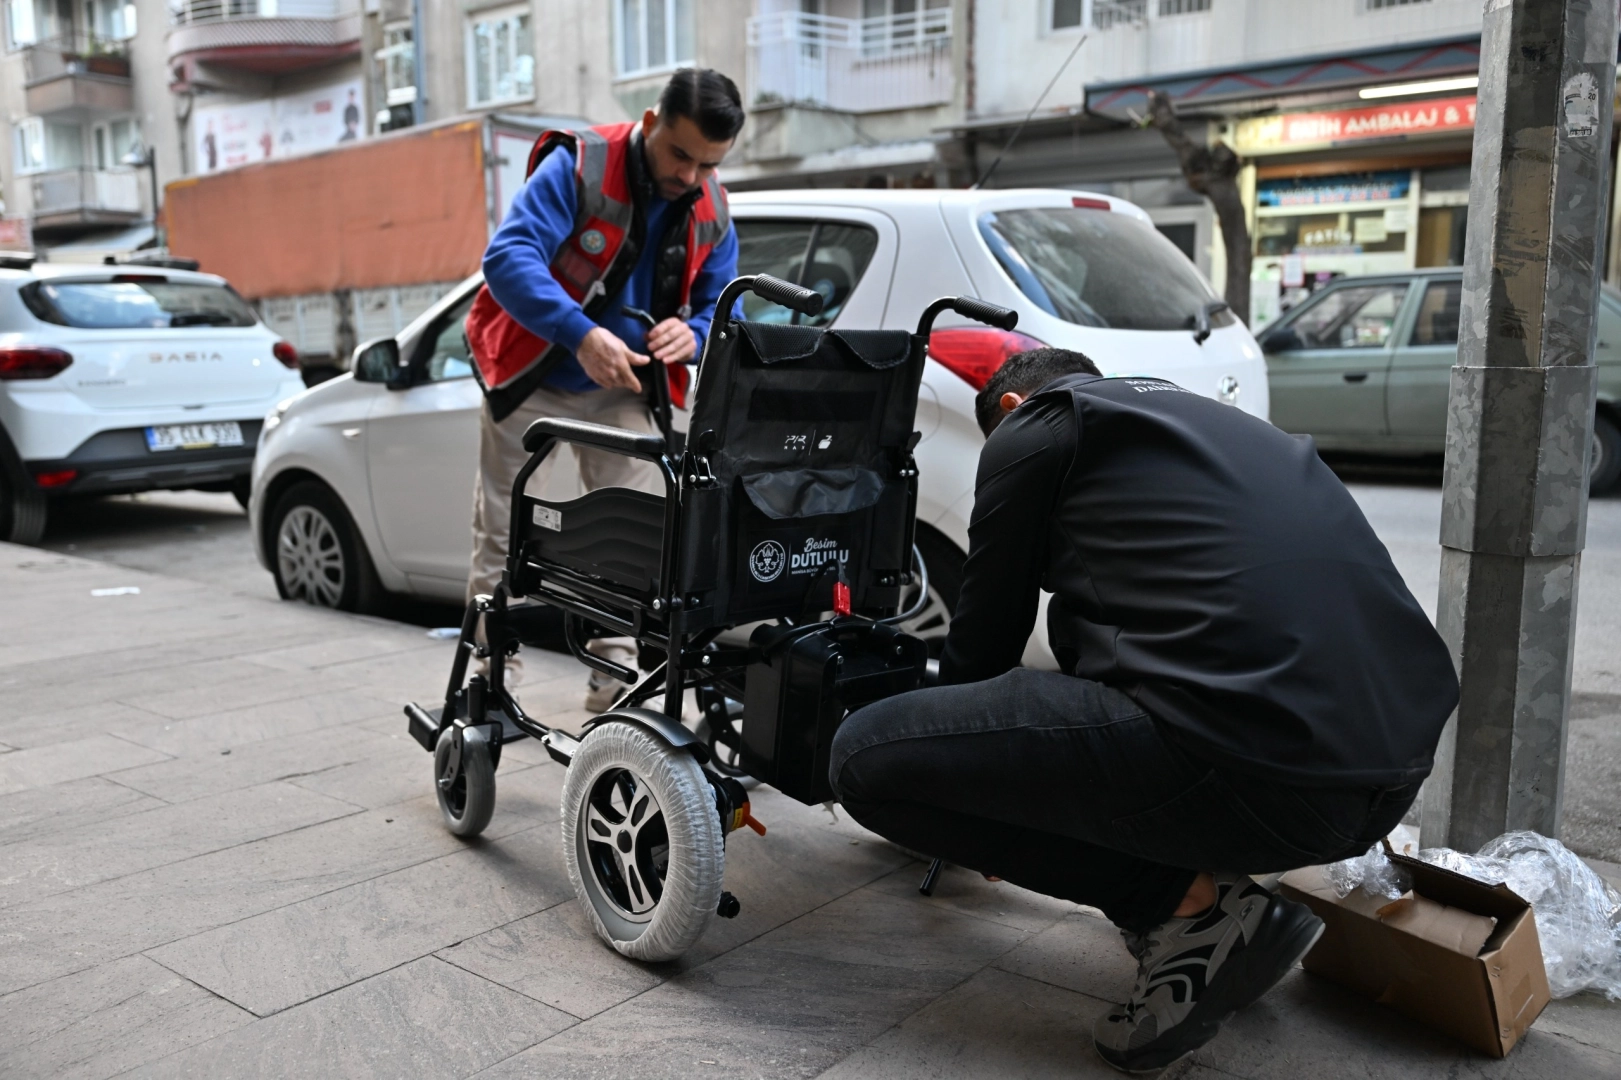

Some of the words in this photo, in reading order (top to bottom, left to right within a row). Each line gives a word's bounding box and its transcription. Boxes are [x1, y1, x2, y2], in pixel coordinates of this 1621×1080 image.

[1345, 107, 1438, 133] AMBALAJ
[1445, 105, 1460, 124] &
[804, 537, 837, 553] Besim
